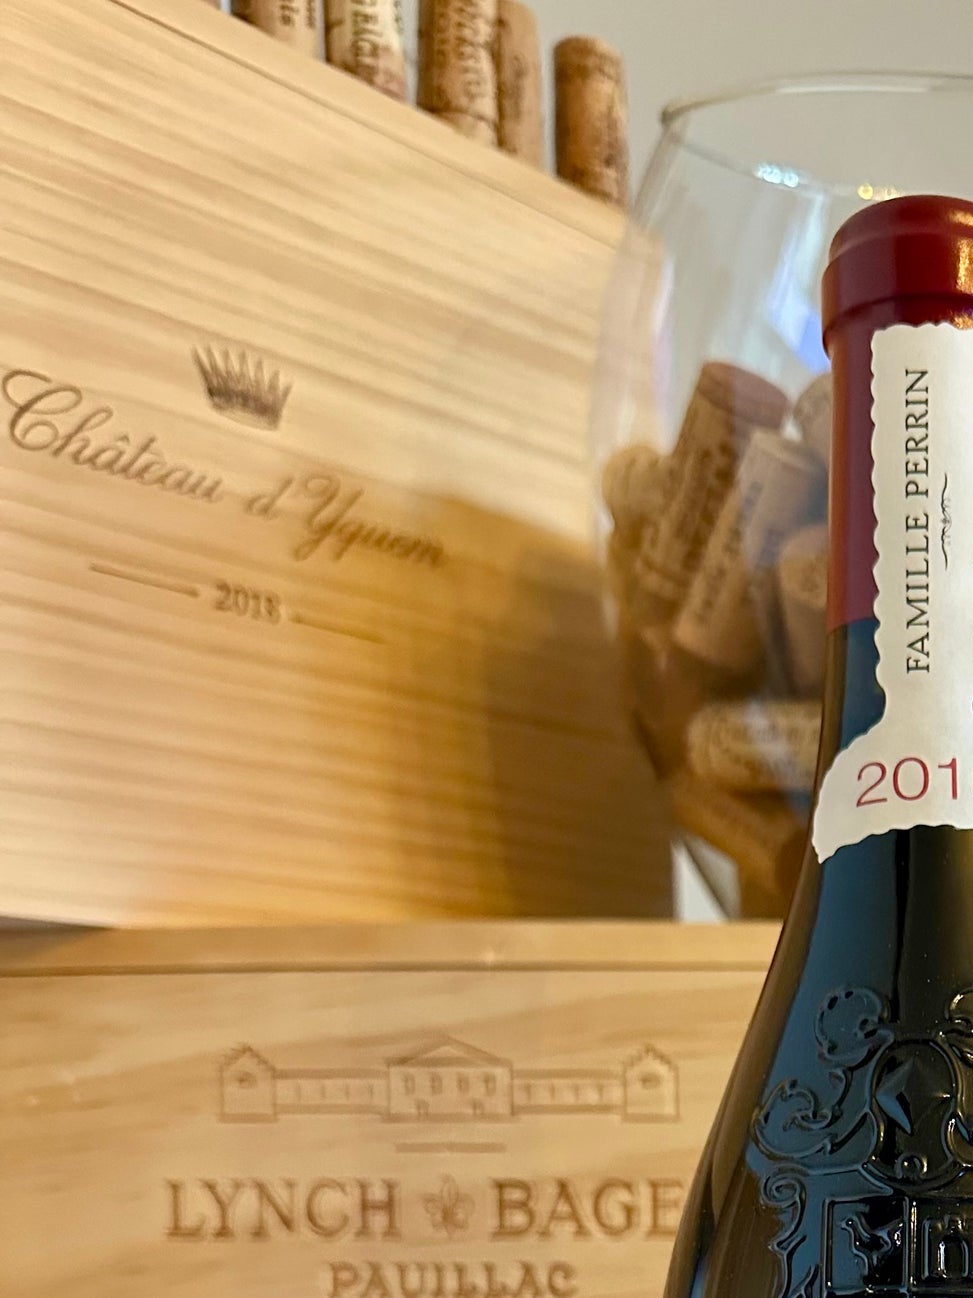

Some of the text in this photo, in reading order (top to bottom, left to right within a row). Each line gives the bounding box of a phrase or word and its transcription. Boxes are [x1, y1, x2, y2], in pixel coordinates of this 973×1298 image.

[2, 369, 223, 503] Château
[904, 369, 931, 674] FAMILLE PERRIN
[164, 1177, 400, 1242] LYNCH
